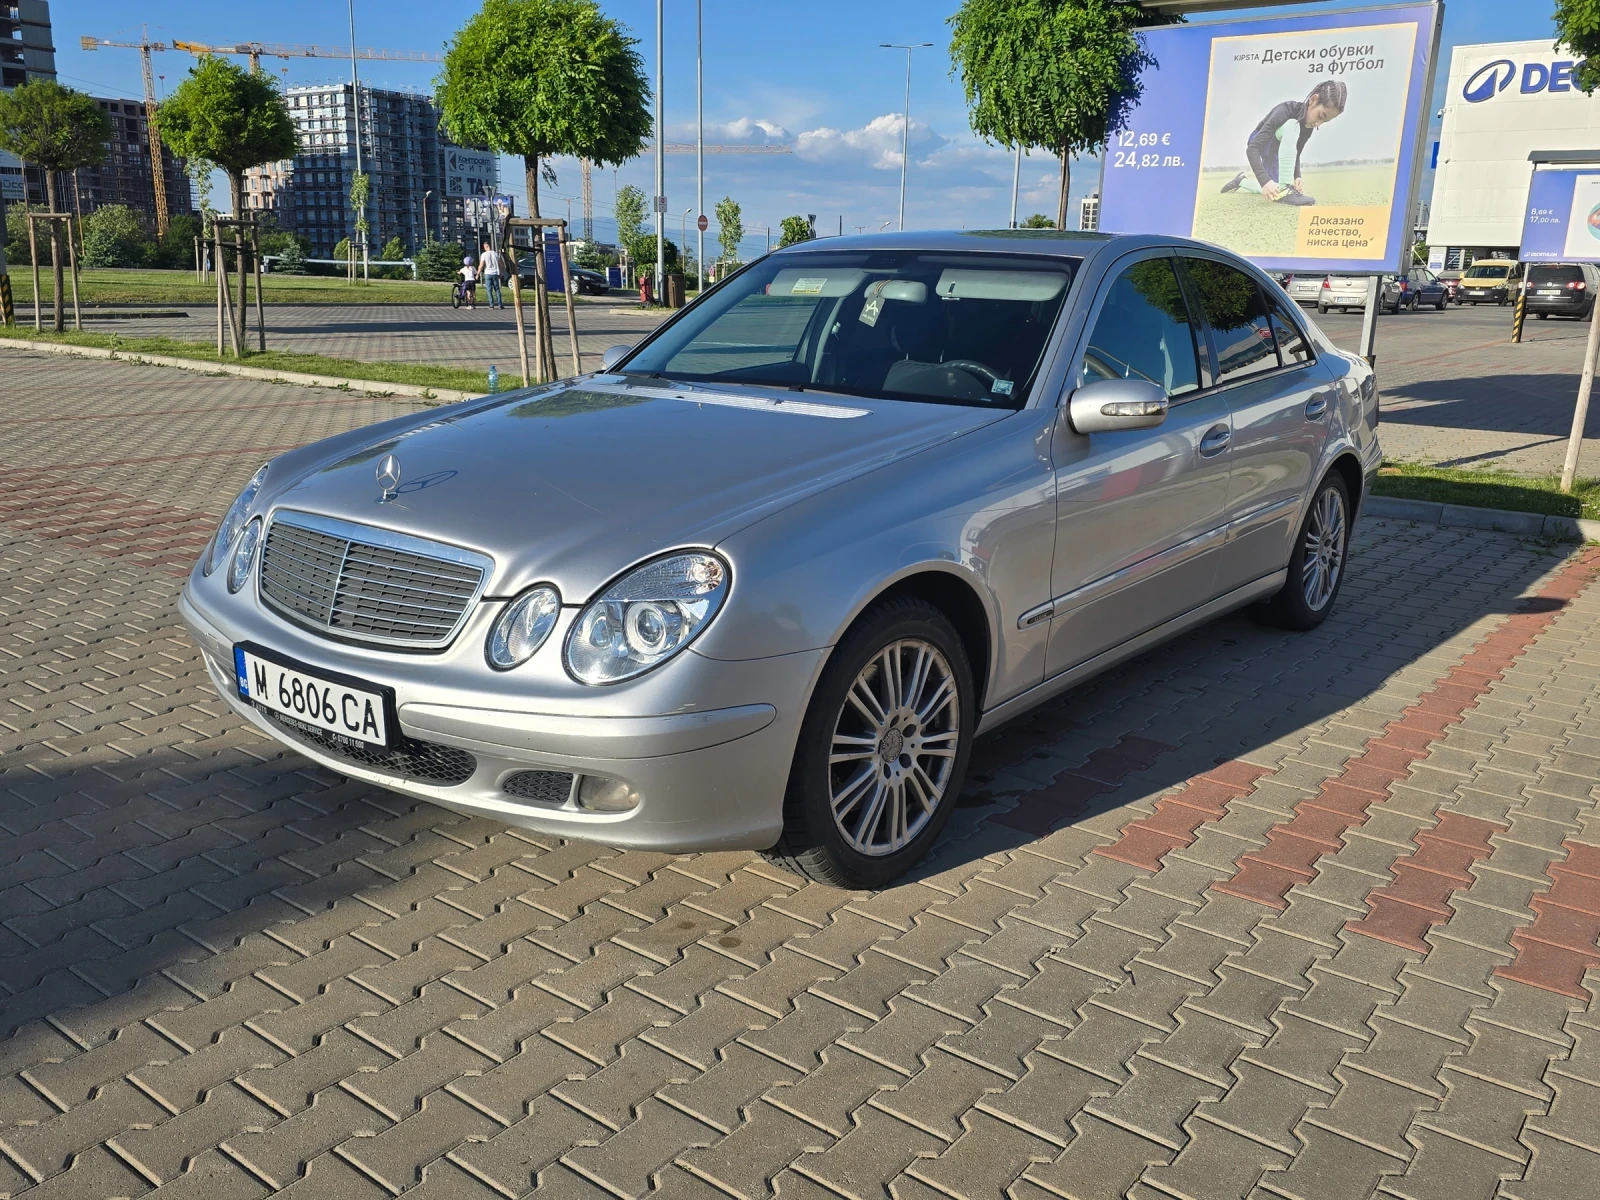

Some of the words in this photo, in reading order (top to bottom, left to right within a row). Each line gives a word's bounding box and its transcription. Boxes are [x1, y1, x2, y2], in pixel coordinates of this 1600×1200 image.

[1234, 53, 1260, 62] KIPSTA
[1262, 49, 1316, 64] Детски
[1319, 45, 1374, 60] обувки
[1308, 63, 1324, 73] за
[1328, 58, 1385, 75] футбол
[1118, 130, 1158, 149] 12,69
[1161, 133, 1171, 145] €
[1114, 151, 1160, 170] 24,82
[1162, 156, 1185, 167] лв.
[458, 164, 492, 173] СИТИ
[1310, 215, 1365, 227] Доказано
[1530, 216, 1550, 224] 17,00
[1308, 228, 1362, 238] качество,
[1307, 238, 1339, 247] ниска
[1341, 239, 1369, 249] цена
[239, 677, 248, 689] BG
[254, 661, 268, 699] M
[279, 673, 336, 724] 6806
